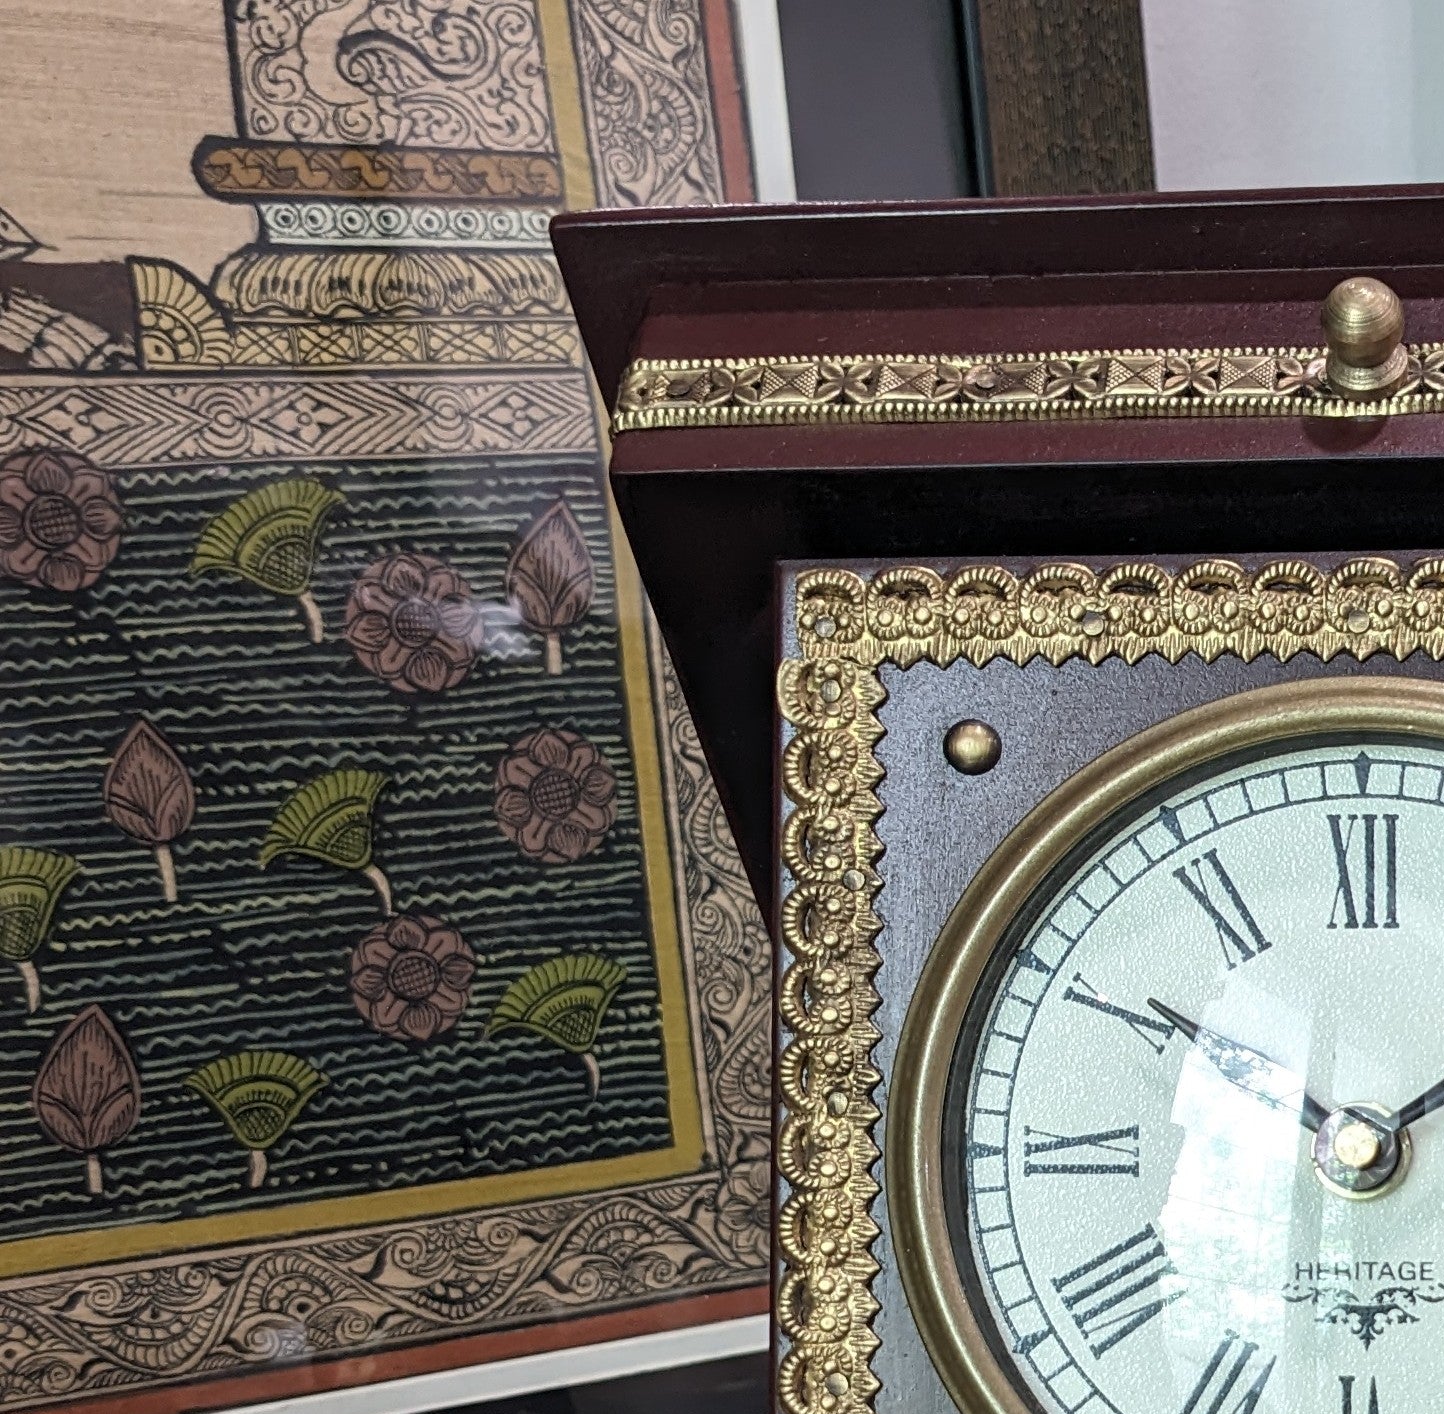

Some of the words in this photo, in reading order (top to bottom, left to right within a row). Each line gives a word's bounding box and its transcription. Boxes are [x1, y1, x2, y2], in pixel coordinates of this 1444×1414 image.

[1172, 848, 1272, 969] XI
[1326, 814, 1400, 929] XII
[1062, 971, 1176, 1056] X
[1023, 1124, 1140, 1178] IX
[1050, 1222, 1189, 1360] VIII
[1295, 1260, 1435, 1282] HERITAGE
